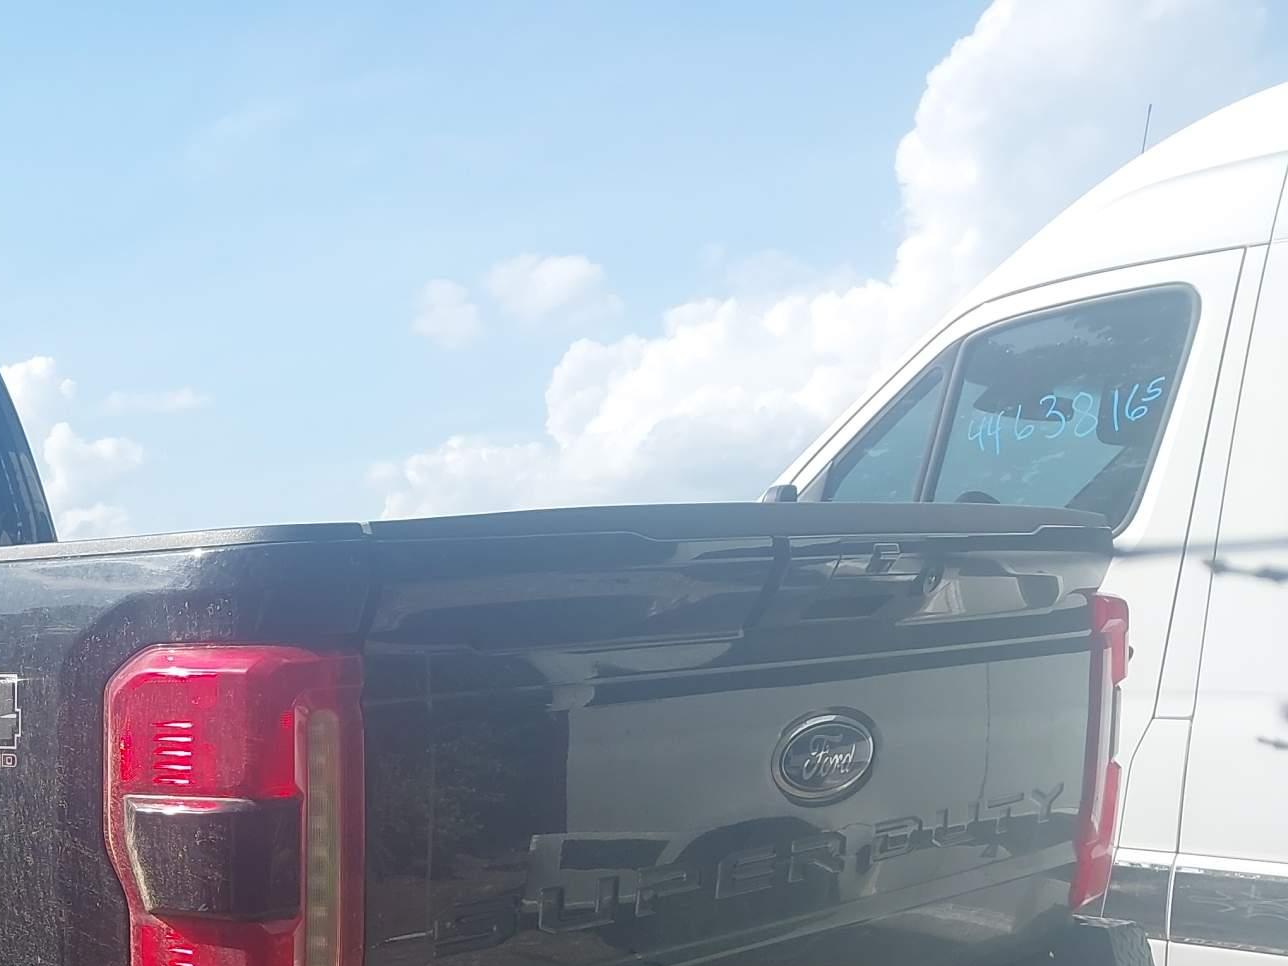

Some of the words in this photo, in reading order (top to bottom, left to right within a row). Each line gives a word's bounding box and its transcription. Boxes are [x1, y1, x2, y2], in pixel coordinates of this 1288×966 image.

[801, 733, 857, 781] Ford
[433, 829, 847, 958] SUPER
[868, 782, 1065, 864] DUTY
